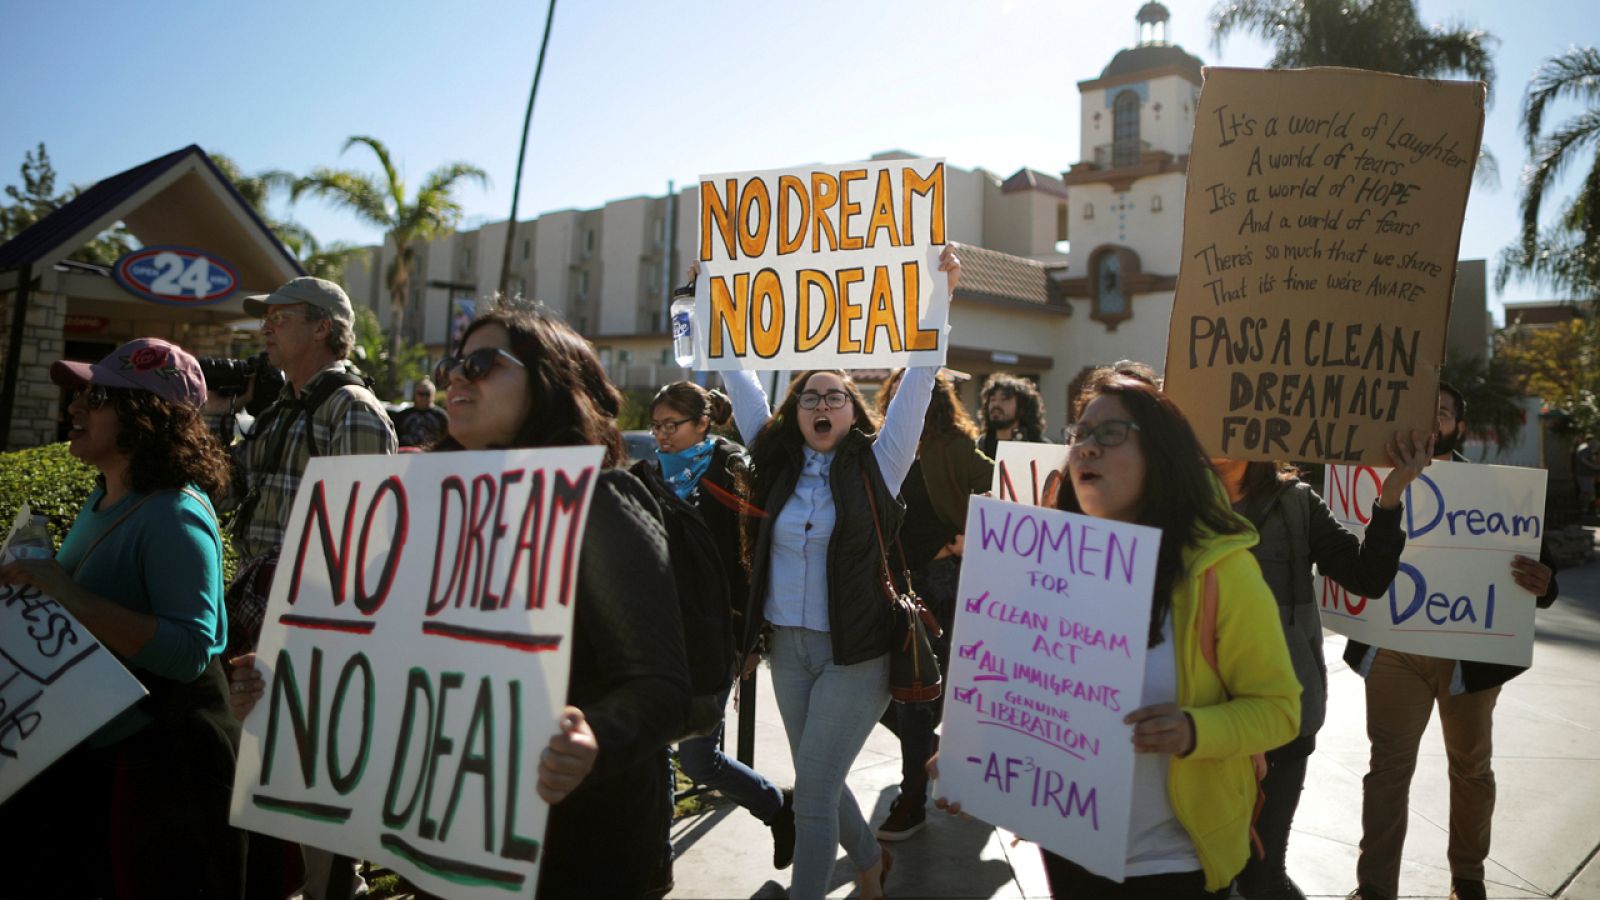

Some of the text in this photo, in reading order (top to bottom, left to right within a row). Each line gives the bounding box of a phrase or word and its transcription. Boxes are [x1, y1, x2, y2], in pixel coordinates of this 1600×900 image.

[1247, 143, 1405, 177] A world of tears
[1264, 117, 1278, 139] a
[1288, 112, 1355, 140] world
[1361, 112, 1388, 141] of
[1387, 117, 1469, 170] Laughter
[700, 162, 946, 262] NO DREAM
[1246, 188, 1260, 204] a
[1268, 177, 1324, 199] world
[1328, 174, 1356, 200] of
[1354, 177, 1422, 207] HOPE
[1238, 209, 1420, 237] And a world of fears
[151, 252, 211, 298] 24
[1203, 275, 1248, 306] That
[1283, 266, 1318, 291] time
[1366, 275, 1426, 302] AWARE
[1265, 244, 1279, 260] so
[1283, 238, 1322, 260] much
[1327, 239, 1369, 266] that
[1373, 253, 1392, 268] we
[1396, 250, 1442, 278] share
[708, 260, 939, 359] NO DEAL
[1189, 315, 1421, 377] PASS A CLEAN
[1229, 371, 1409, 422] DREAM ACT
[1221, 416, 1367, 461] FOR ALL
[1405, 473, 1541, 540] Dream
[288, 465, 595, 616] NO DREAM
[980, 507, 1138, 585] WOMEN
[1026, 570, 1071, 598] FOR
[1388, 561, 1495, 629] Deal
[0, 583, 78, 657] RESS
[988, 600, 1131, 658] CLEAN DREAM
[1032, 634, 1083, 665] ACT
[978, 650, 1121, 712] ALL IMMIGRANTS
[1005, 691, 1070, 723] GENUINE
[976, 692, 1100, 756] LIBERATION
[260, 647, 540, 863] NO DEAL
